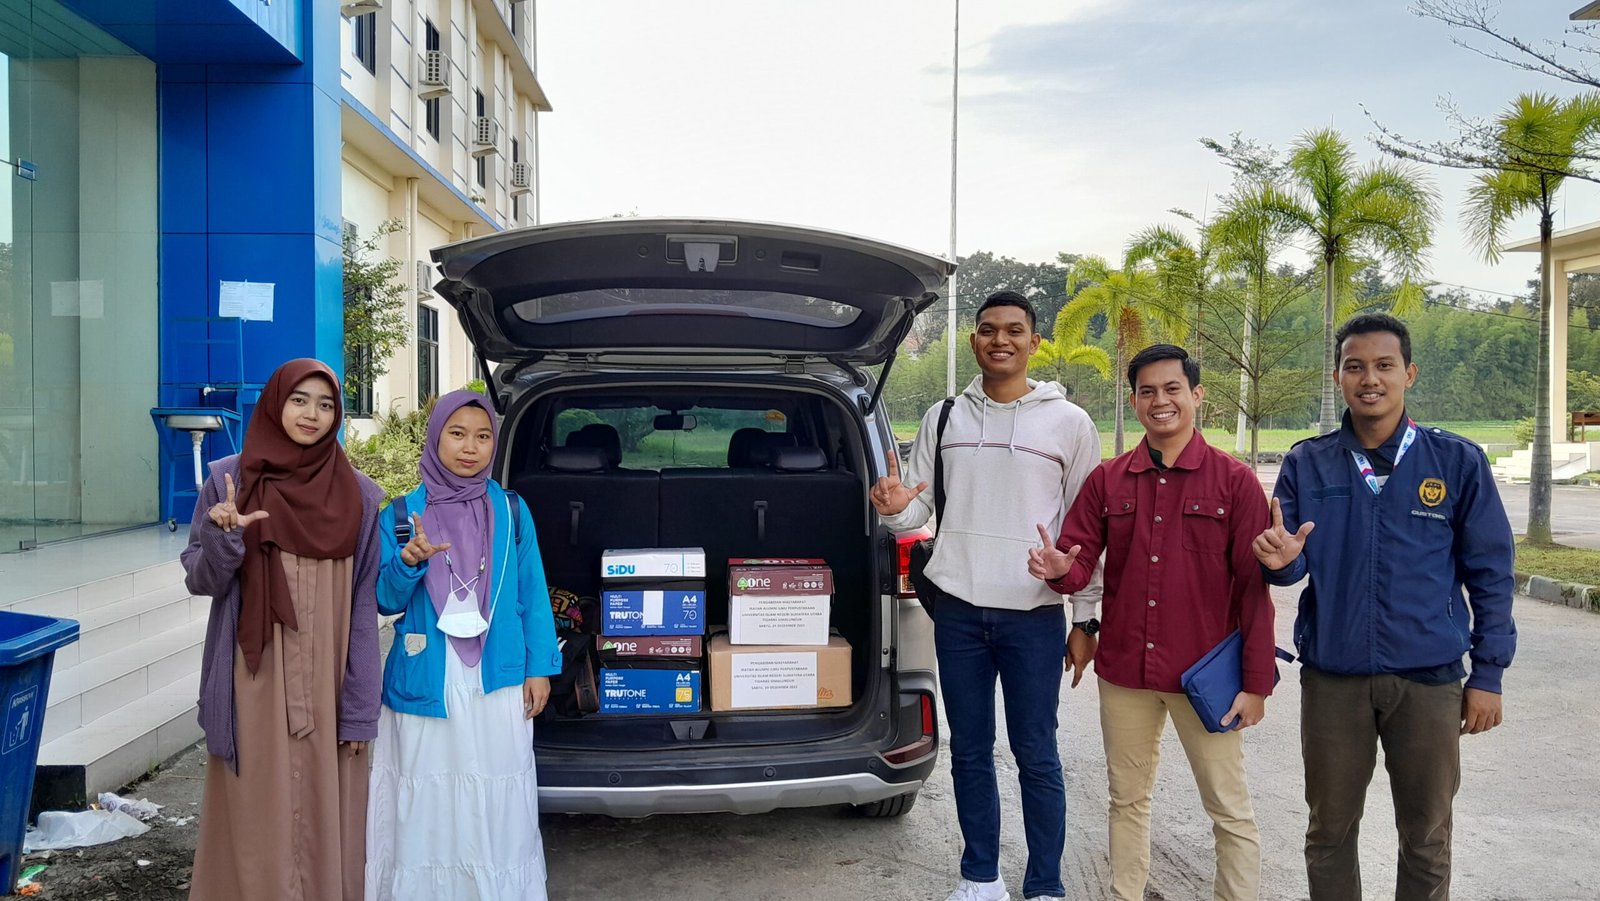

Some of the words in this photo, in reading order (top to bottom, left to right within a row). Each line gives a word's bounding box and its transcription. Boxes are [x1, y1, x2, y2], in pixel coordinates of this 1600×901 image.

[1411, 509, 1446, 520] CUSTOMS
[682, 595, 697, 603] A4
[610, 611, 644, 619] TRUTON
[682, 610, 697, 620] 70
[676, 673, 691, 681] A4
[605, 689, 646, 697] TRUTONE
